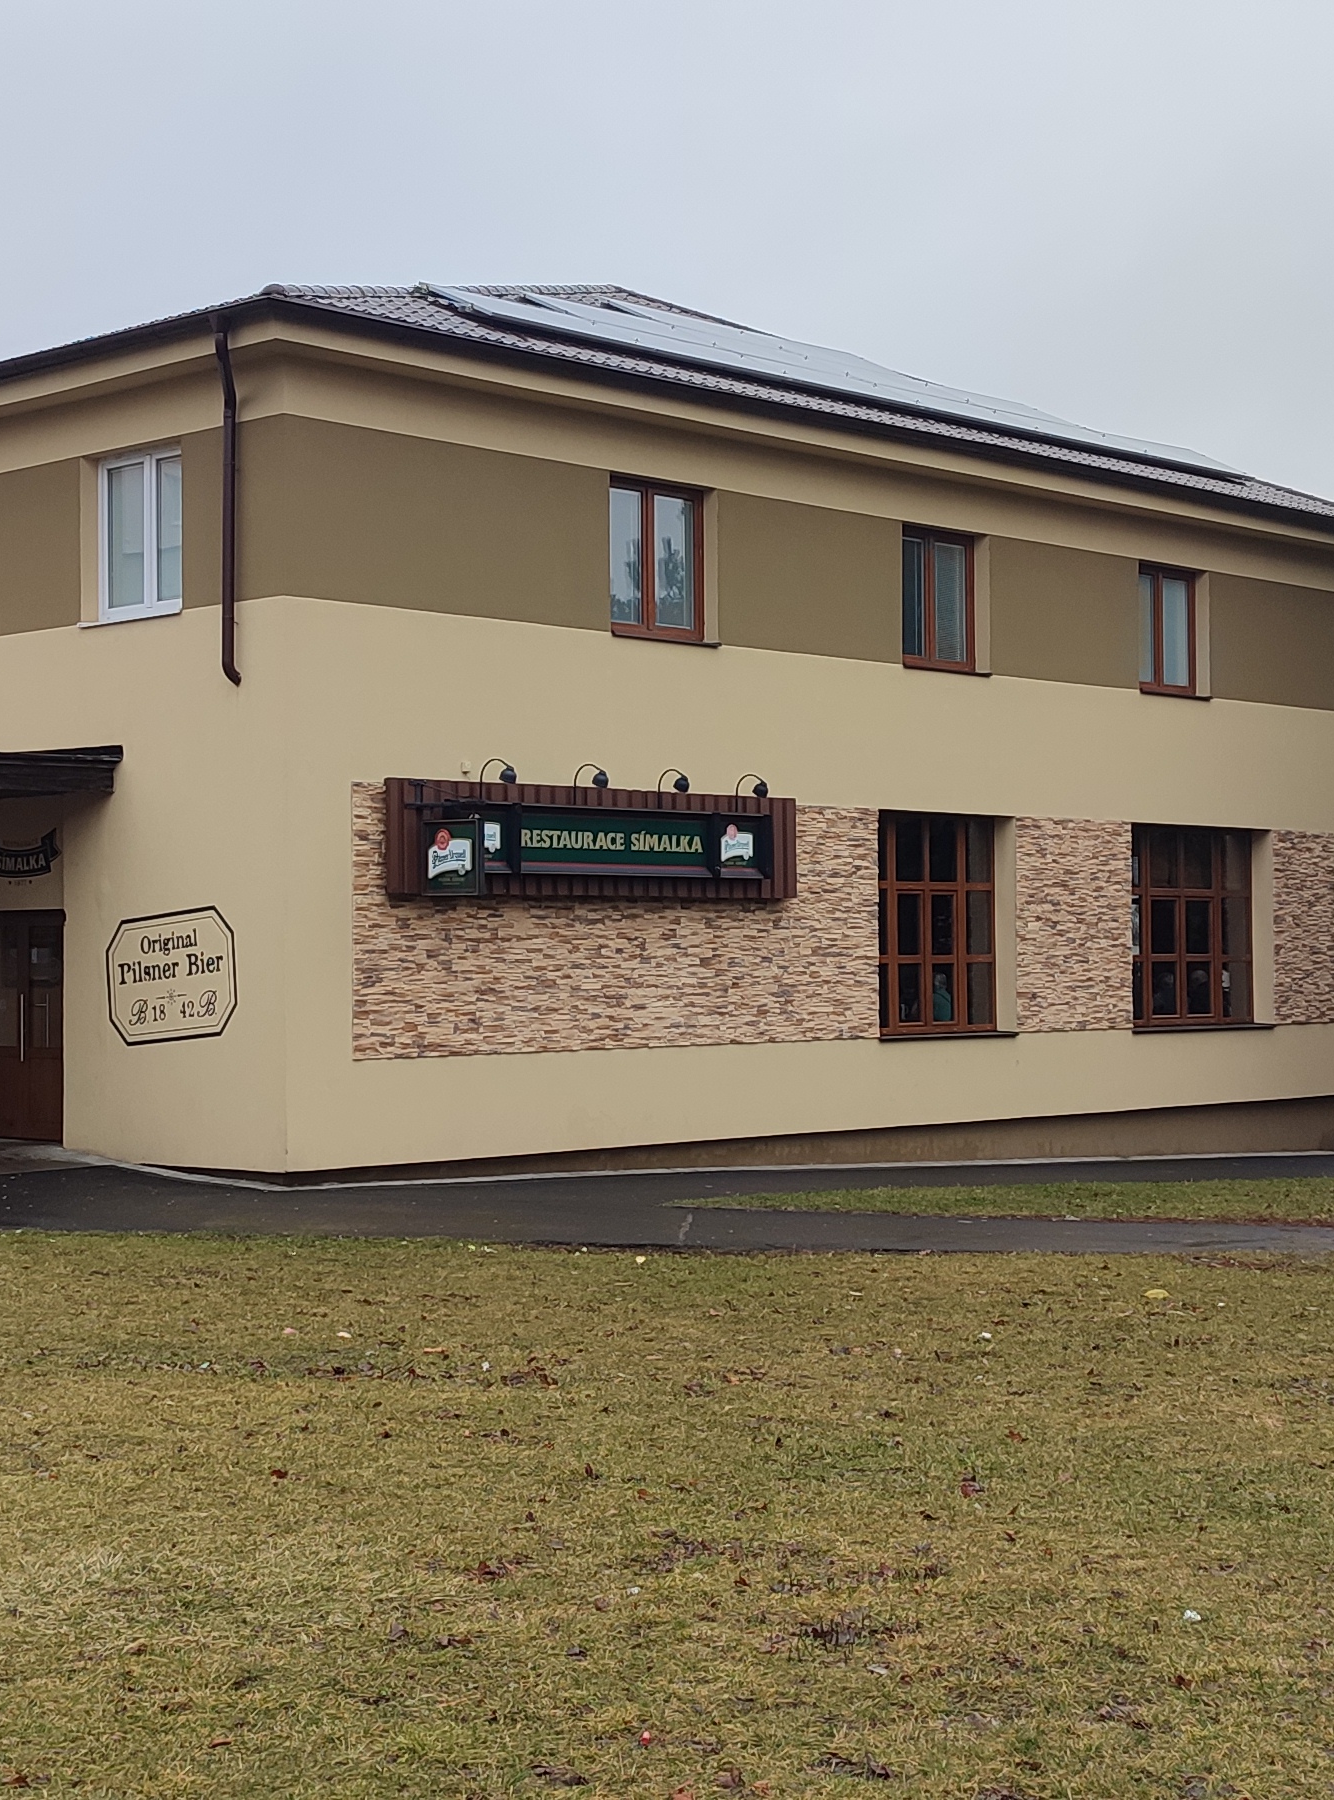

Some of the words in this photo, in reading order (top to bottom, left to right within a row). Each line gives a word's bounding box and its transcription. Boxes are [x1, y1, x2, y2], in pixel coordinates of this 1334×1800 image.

[521, 829, 626, 851] RESTAURACE
[630, 830, 703, 853] SÍMALKA
[140, 928, 198, 956] Original
[118, 960, 179, 985] Pilsner
[186, 951, 223, 976] Bier
